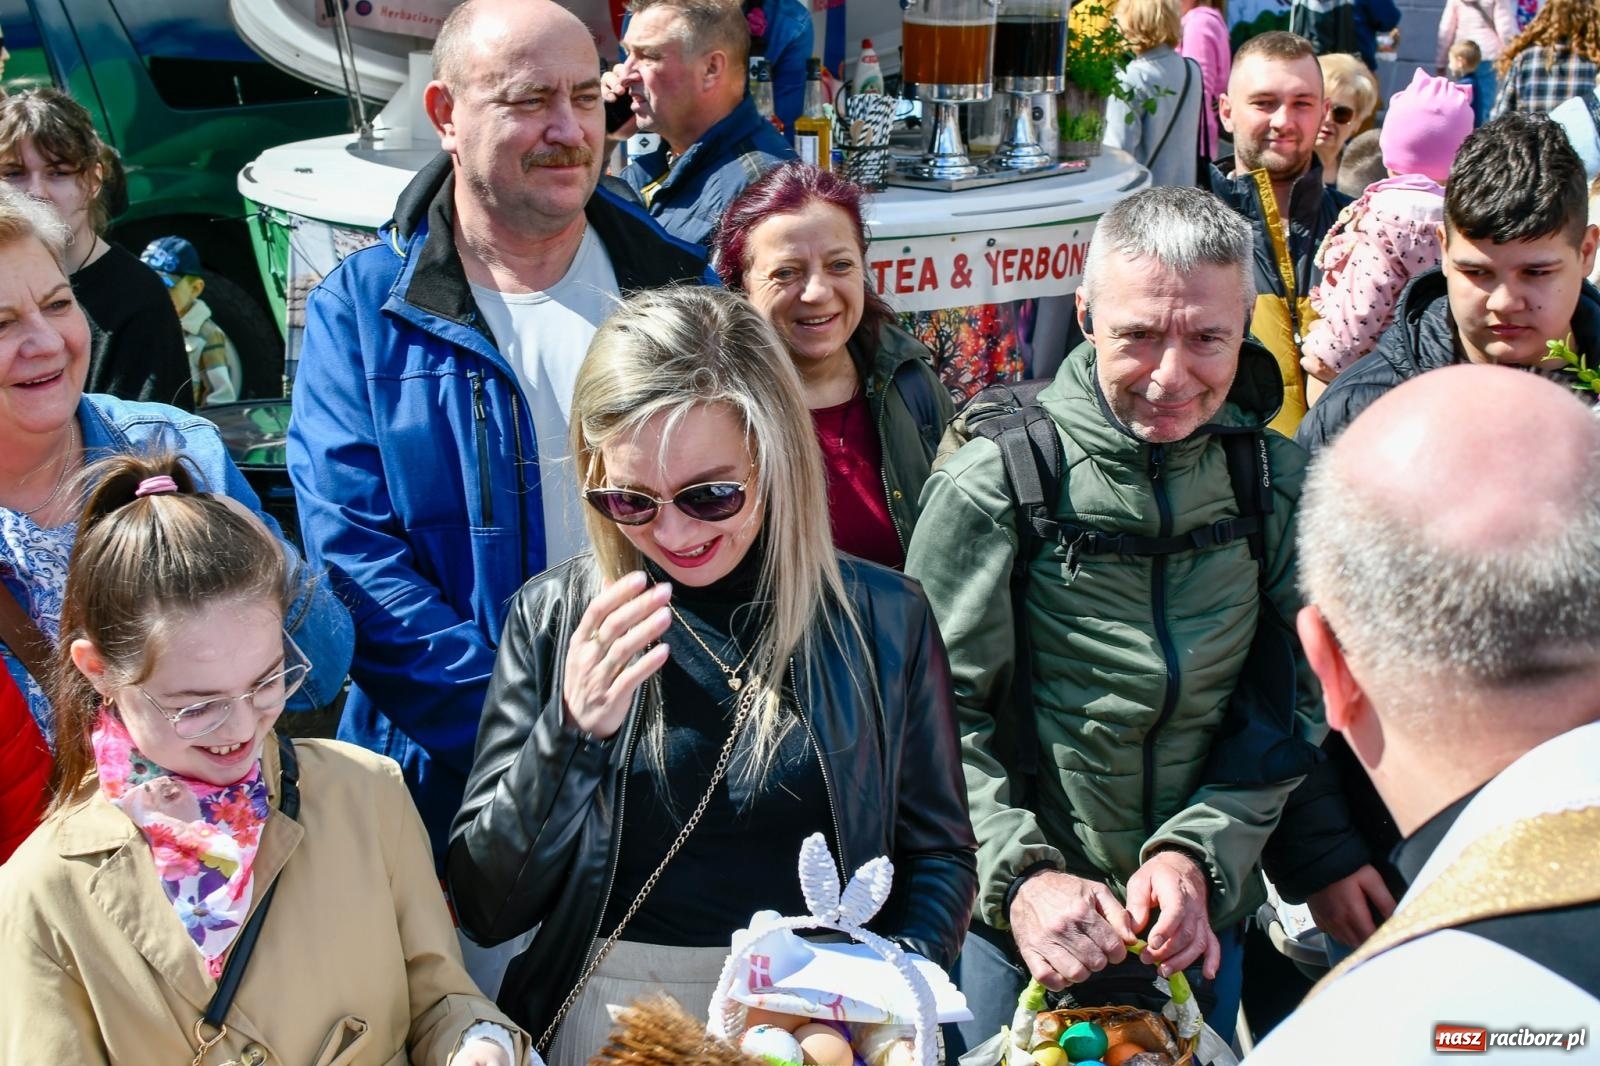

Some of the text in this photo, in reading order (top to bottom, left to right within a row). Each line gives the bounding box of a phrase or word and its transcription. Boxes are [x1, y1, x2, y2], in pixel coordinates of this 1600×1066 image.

[870, 241, 1090, 295] TEA & YERBON
[1259, 439, 1270, 488] Quechua
